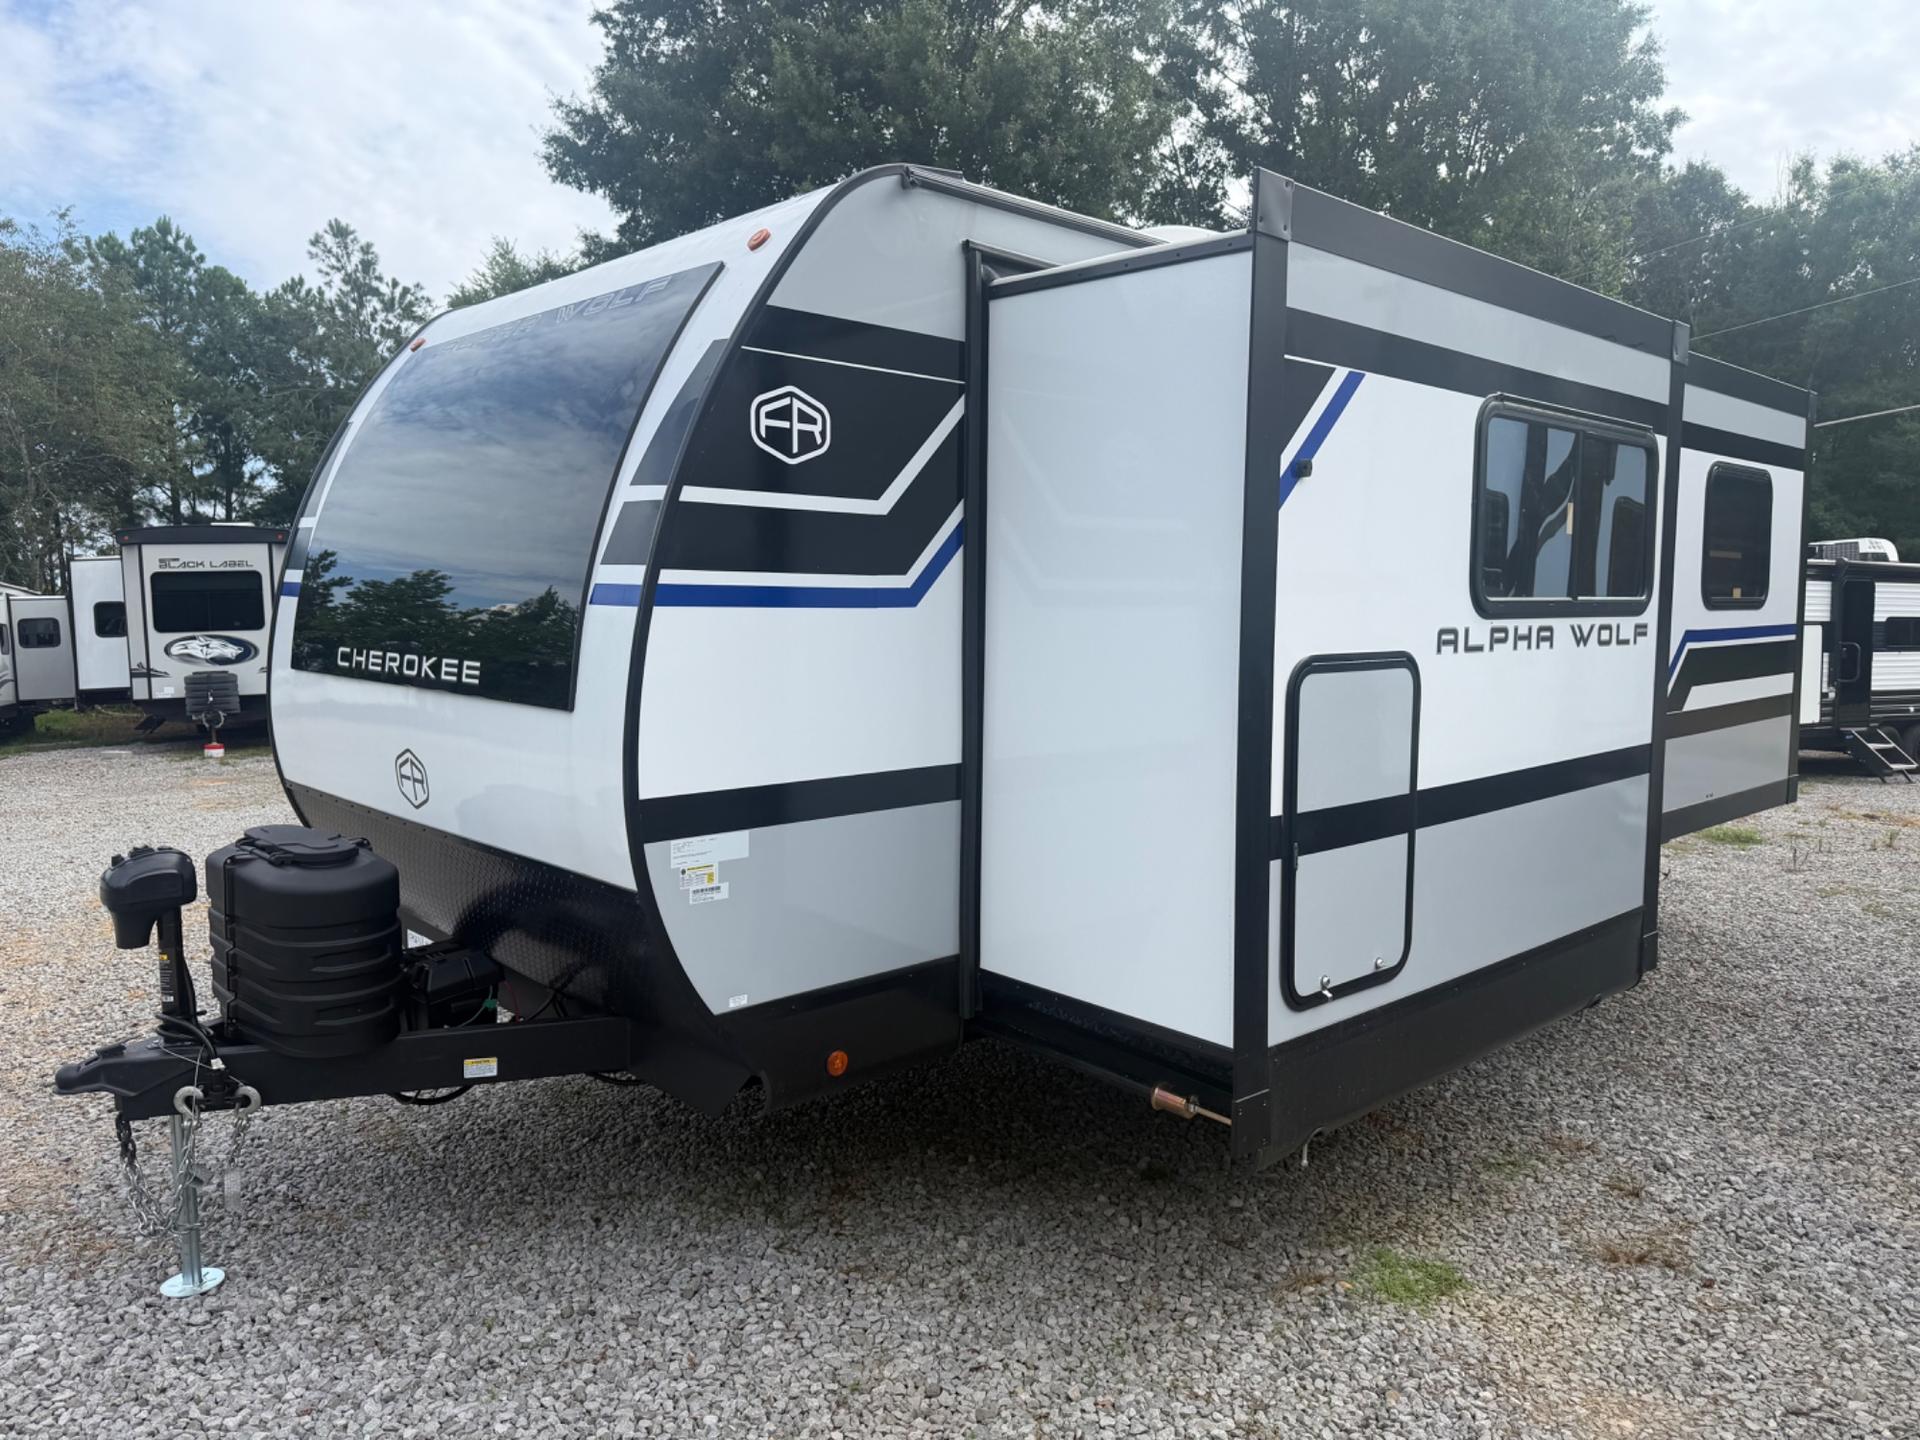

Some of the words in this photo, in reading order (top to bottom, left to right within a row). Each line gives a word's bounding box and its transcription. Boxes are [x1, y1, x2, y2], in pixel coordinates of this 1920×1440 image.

[555, 275, 672, 324] WOLF
[158, 560, 206, 570] BLACK
[209, 560, 254, 569] LABEL
[1436, 625, 1554, 655] ALPHA
[1570, 623, 1648, 648] WOLF
[337, 646, 481, 685] CHEROKEE
